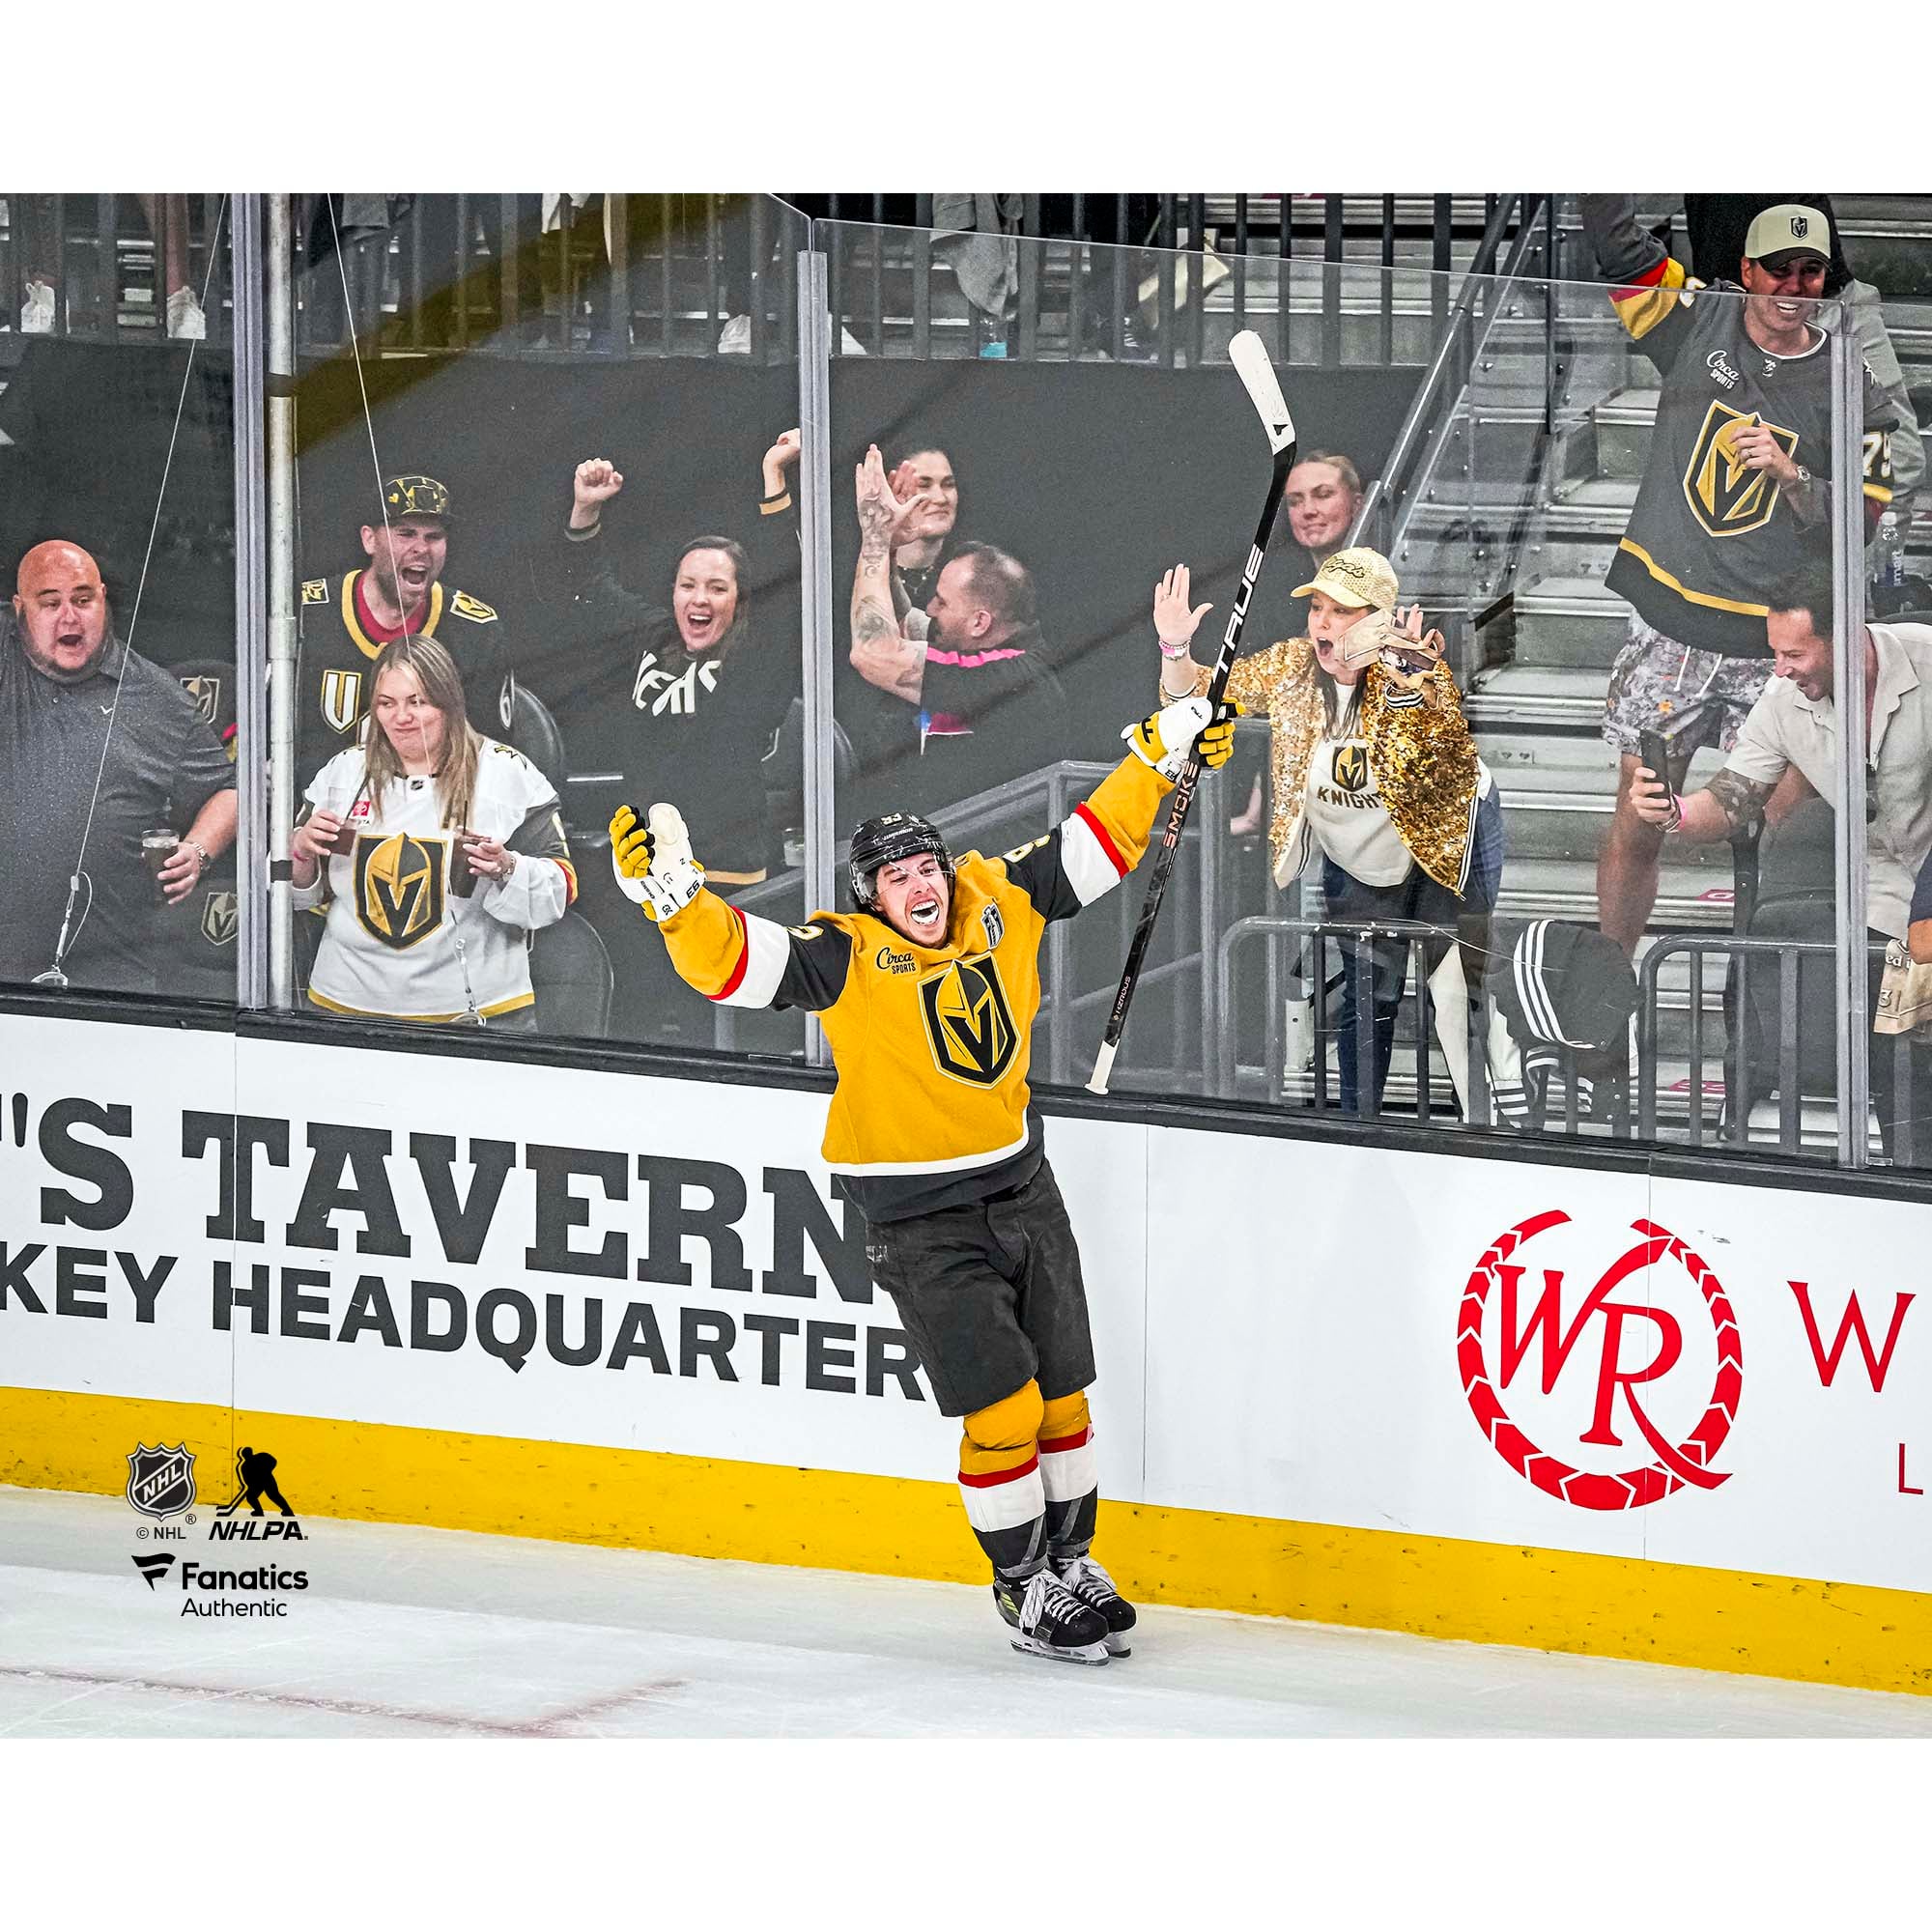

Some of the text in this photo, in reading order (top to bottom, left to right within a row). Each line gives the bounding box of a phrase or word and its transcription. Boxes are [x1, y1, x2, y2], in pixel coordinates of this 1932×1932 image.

[1706, 350, 1740, 381] Circa
[1710, 368, 1735, 389] SPORTS
[1212, 543, 1264, 684] TRUE
[1162, 760, 1198, 850] SMOKE
[876, 947, 914, 970] Circa
[892, 962, 916, 975] SPORTS
[0, 1092, 874, 1305] 'S TAVERN
[0, 1241, 179, 1324] KEY
